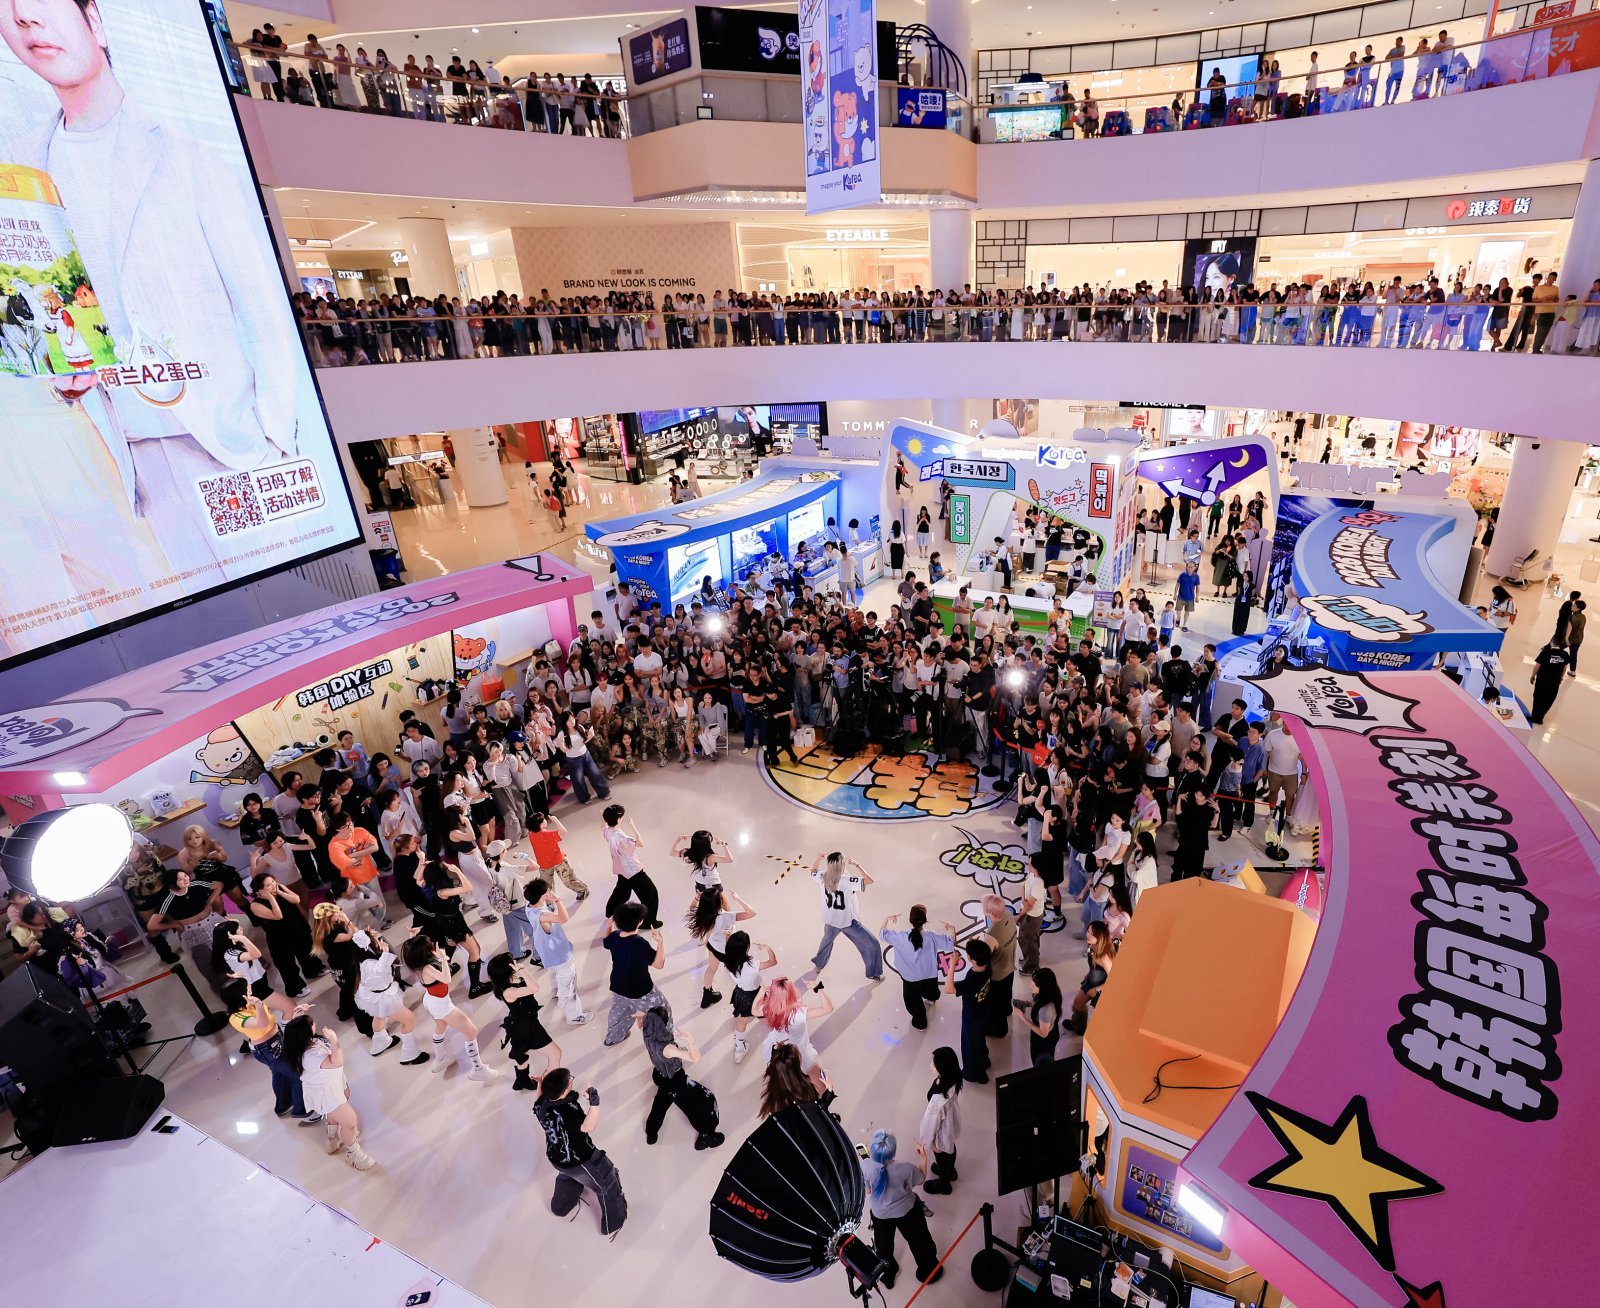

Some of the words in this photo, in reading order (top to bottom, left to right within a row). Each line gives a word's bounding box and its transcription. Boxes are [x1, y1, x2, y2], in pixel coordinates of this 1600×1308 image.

[843, 172, 862, 191] Korea
[1468, 197, 1531, 217] 银泰百货
[827, 229, 888, 241] EYEABLE
[563, 280, 595, 288] BRAND
[598, 279, 619, 287] NEW
[621, 279, 646, 287] LOOK
[648, 279, 657, 287] IS
[658, 278, 696, 287] COMING
[98, 361, 202, 388] 荷兰A2蛋白
[842, 420, 890, 432] TOMM
[1038, 445, 1085, 465] Korea
[256, 466, 314, 493] 扫码了解
[950, 463, 1001, 477] 한국시장
[263, 486, 320, 514] 活动详情
[1094, 468, 1109, 512] 떡볶이
[1332, 527, 1374, 559] KOREA
[1364, 534, 1391, 556] NIGHT
[1332, 556, 1381, 588] 2026
[1364, 561, 1397, 579] DAY
[629, 585, 658, 599] Korea
[342, 597, 409, 622] DAY
[346, 593, 455, 630] 2026
[170, 627, 349, 691] KOREA
[192, 627, 304, 674] NIGHT
[1376, 651, 1411, 663] KOREA
[297, 660, 392, 707] 韩国DIY互动
[328, 682, 374, 710] 体验区
[1305, 683, 1327, 701] your
[1298, 689, 1322, 717] Imagine
[1314, 675, 1379, 722] Korea
[0, 716, 90, 748] Korea
[1376, 737, 1548, 1111] 韩国每时美刻
